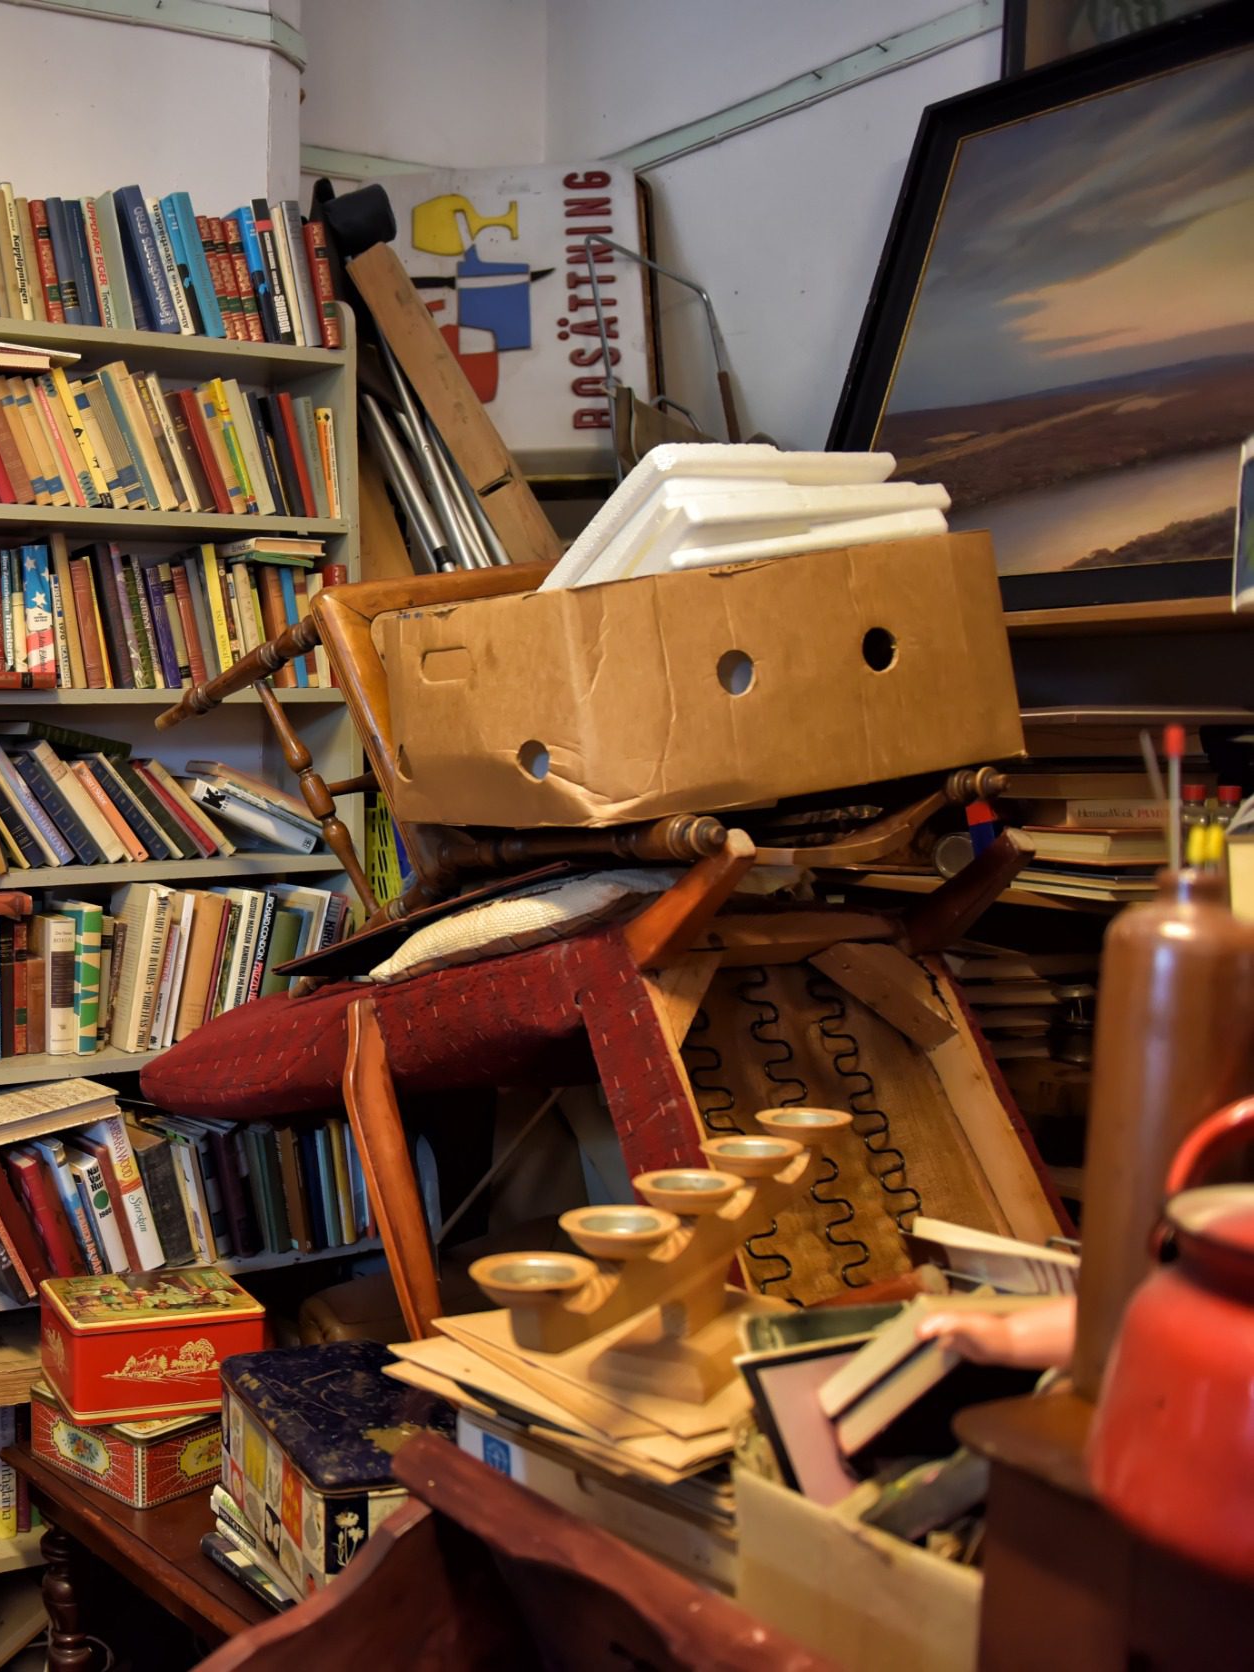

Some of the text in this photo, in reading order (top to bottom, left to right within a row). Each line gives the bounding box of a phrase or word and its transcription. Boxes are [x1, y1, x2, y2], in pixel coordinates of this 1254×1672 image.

[85, 201, 108, 286] UPPDRAG EIGER
[12, 233, 30, 305] Kapplöpningen
[274, 294, 291, 334] SOBIBOR
[4, 612, 14, 666] Turisterna
[58, 622, 66, 640] 1970
[264, 893, 276, 925] RICHARD
[256, 925, 269, 961] CONDON
[89, 1174, 101, 1184] Var
[116, 1150, 133, 1178] WOOD
[91, 1182, 104, 1192] Hur
